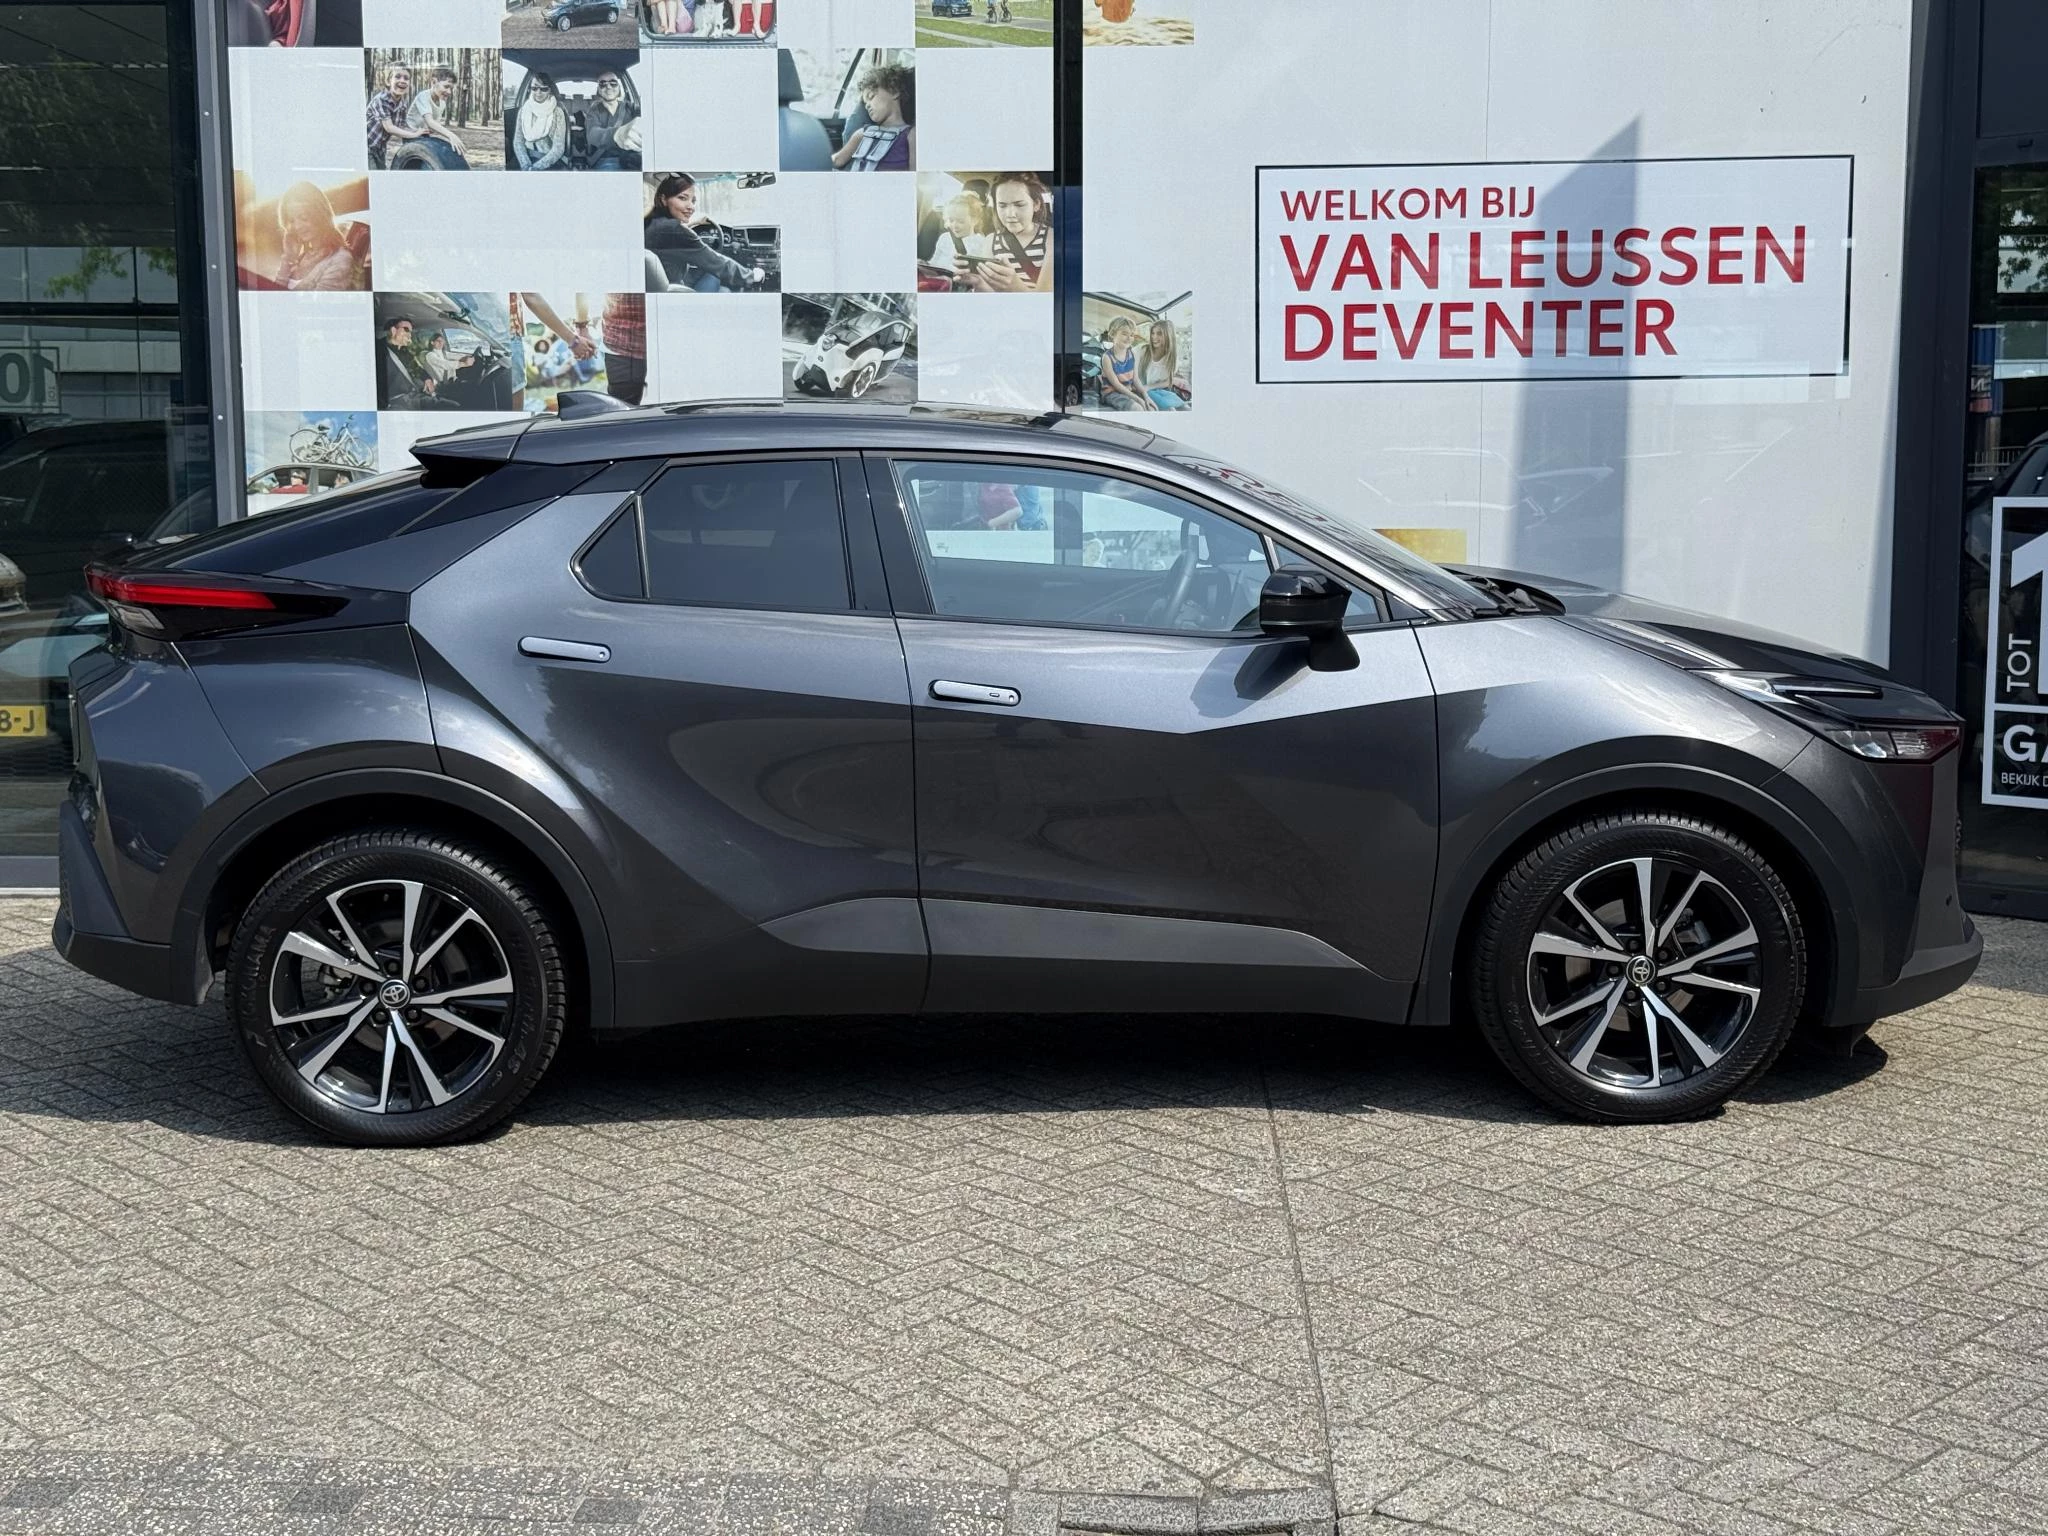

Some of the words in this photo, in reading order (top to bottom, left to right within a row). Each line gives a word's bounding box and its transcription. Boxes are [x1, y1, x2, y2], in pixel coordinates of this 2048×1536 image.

[1280, 187, 1468, 222] WELKOM
[1481, 186, 1535, 219] BIJ
[1279, 232, 1440, 292] VAN
[1468, 225, 1806, 290] LEUSSEN
[1283, 298, 1678, 362] DEVENTER
[2006, 632, 2032, 692] TOT
[2002, 724, 2048, 763] G
[2001, 772, 2040, 787] BEKIJK
